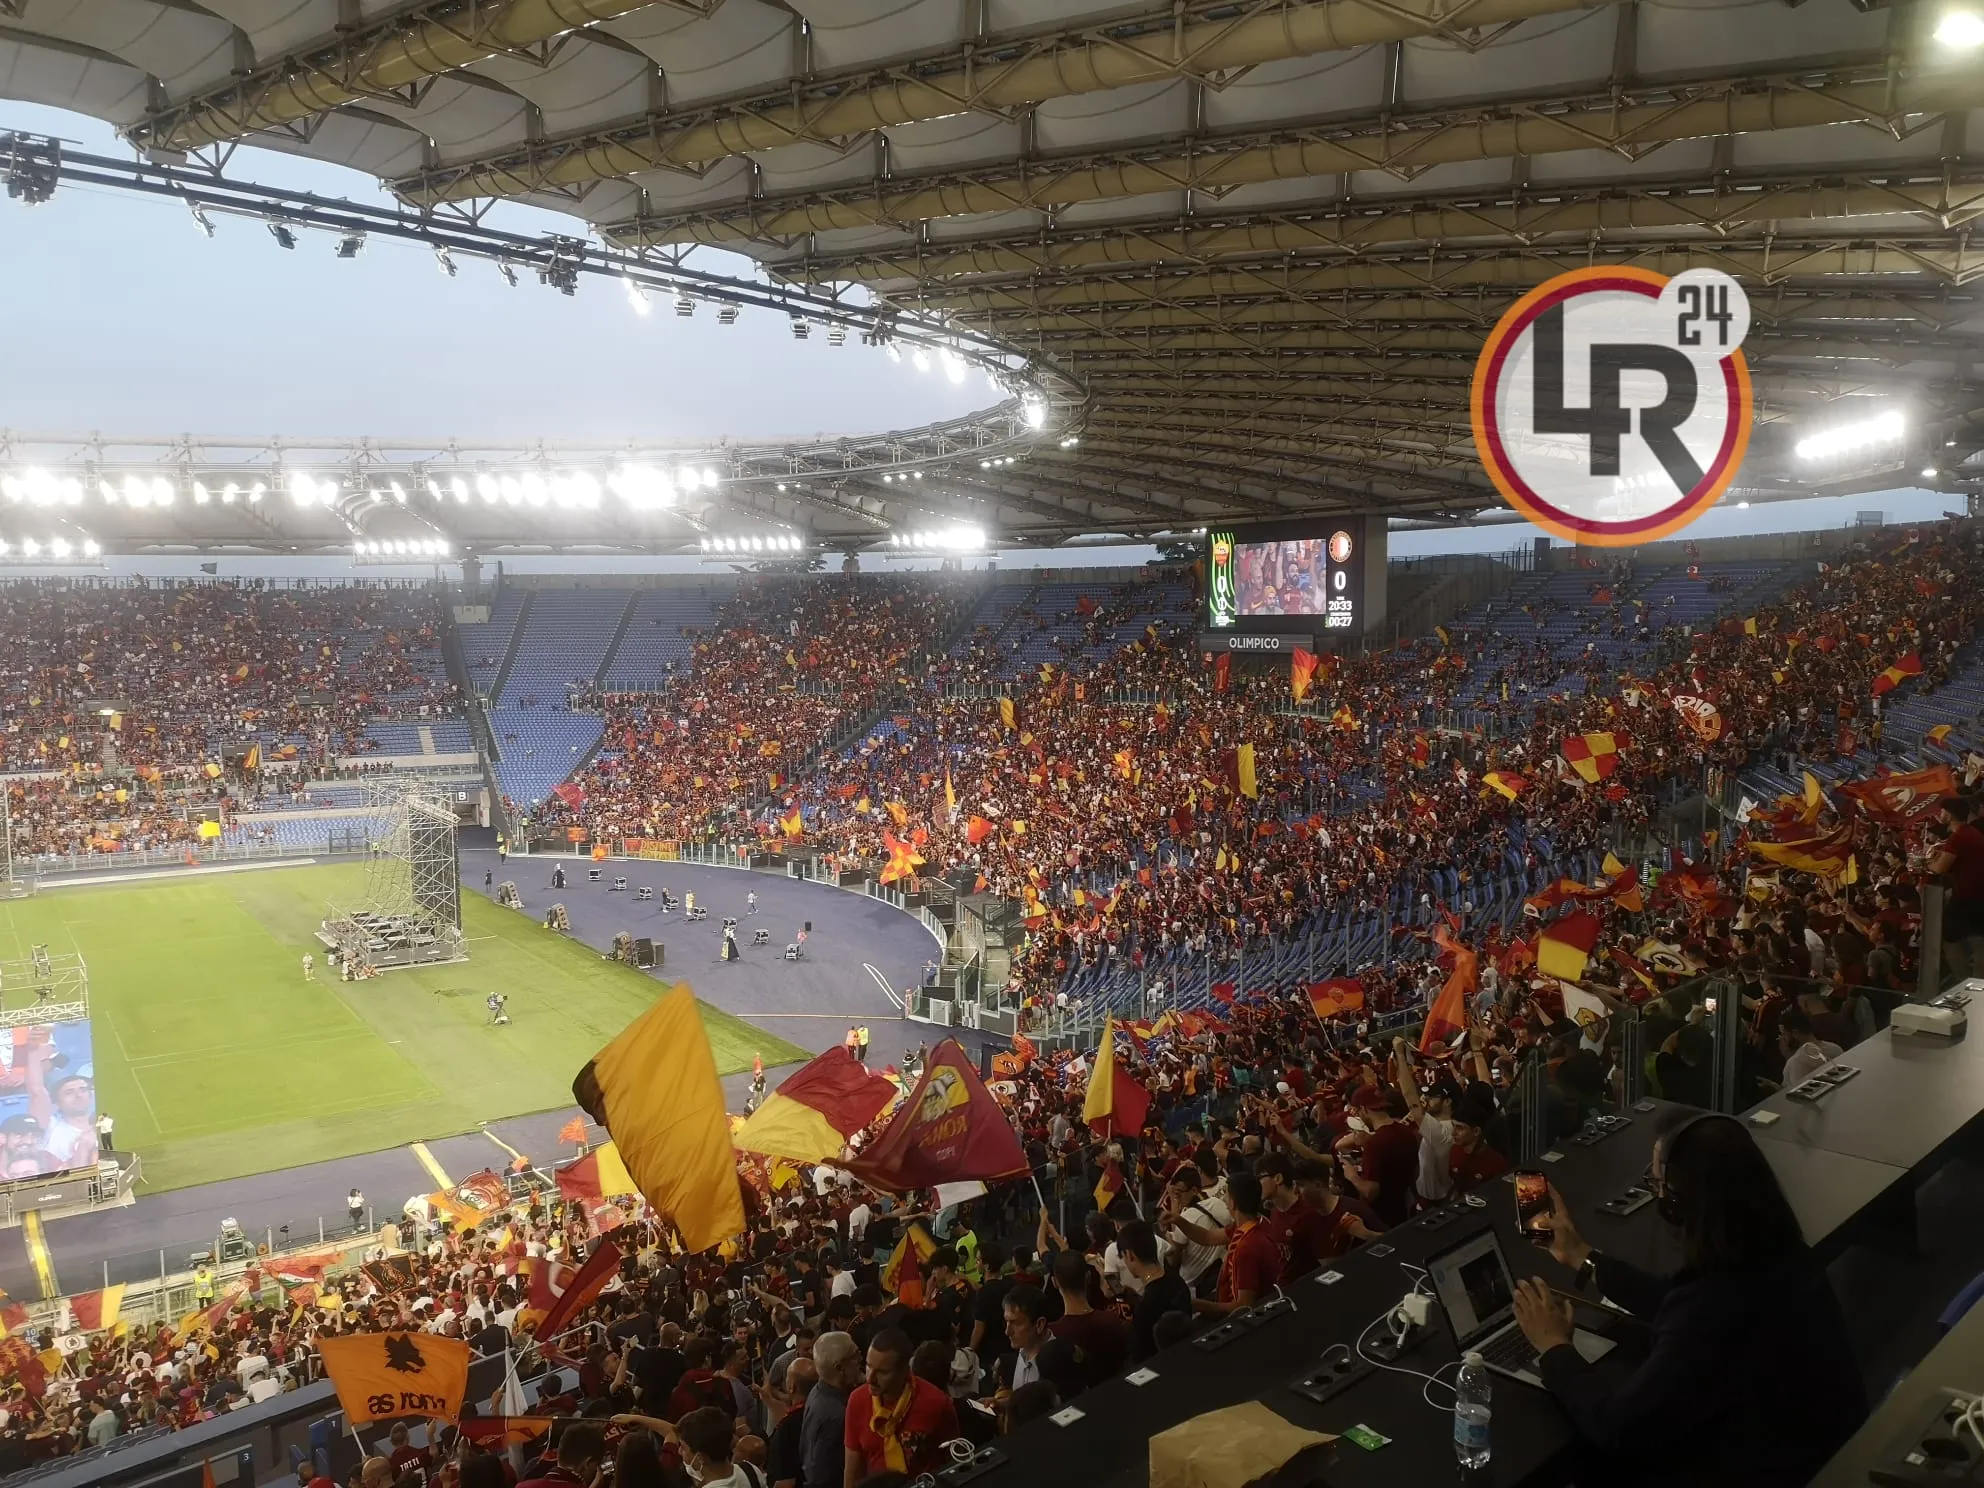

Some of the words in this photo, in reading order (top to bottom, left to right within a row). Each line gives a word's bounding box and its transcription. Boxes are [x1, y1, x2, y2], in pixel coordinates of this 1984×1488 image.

[1334, 571, 1346, 590] 0
[1229, 637, 1280, 649] OLIMPICO
[368, 1393, 396, 1415] as
[399, 1456, 420, 1472] TOTTI
